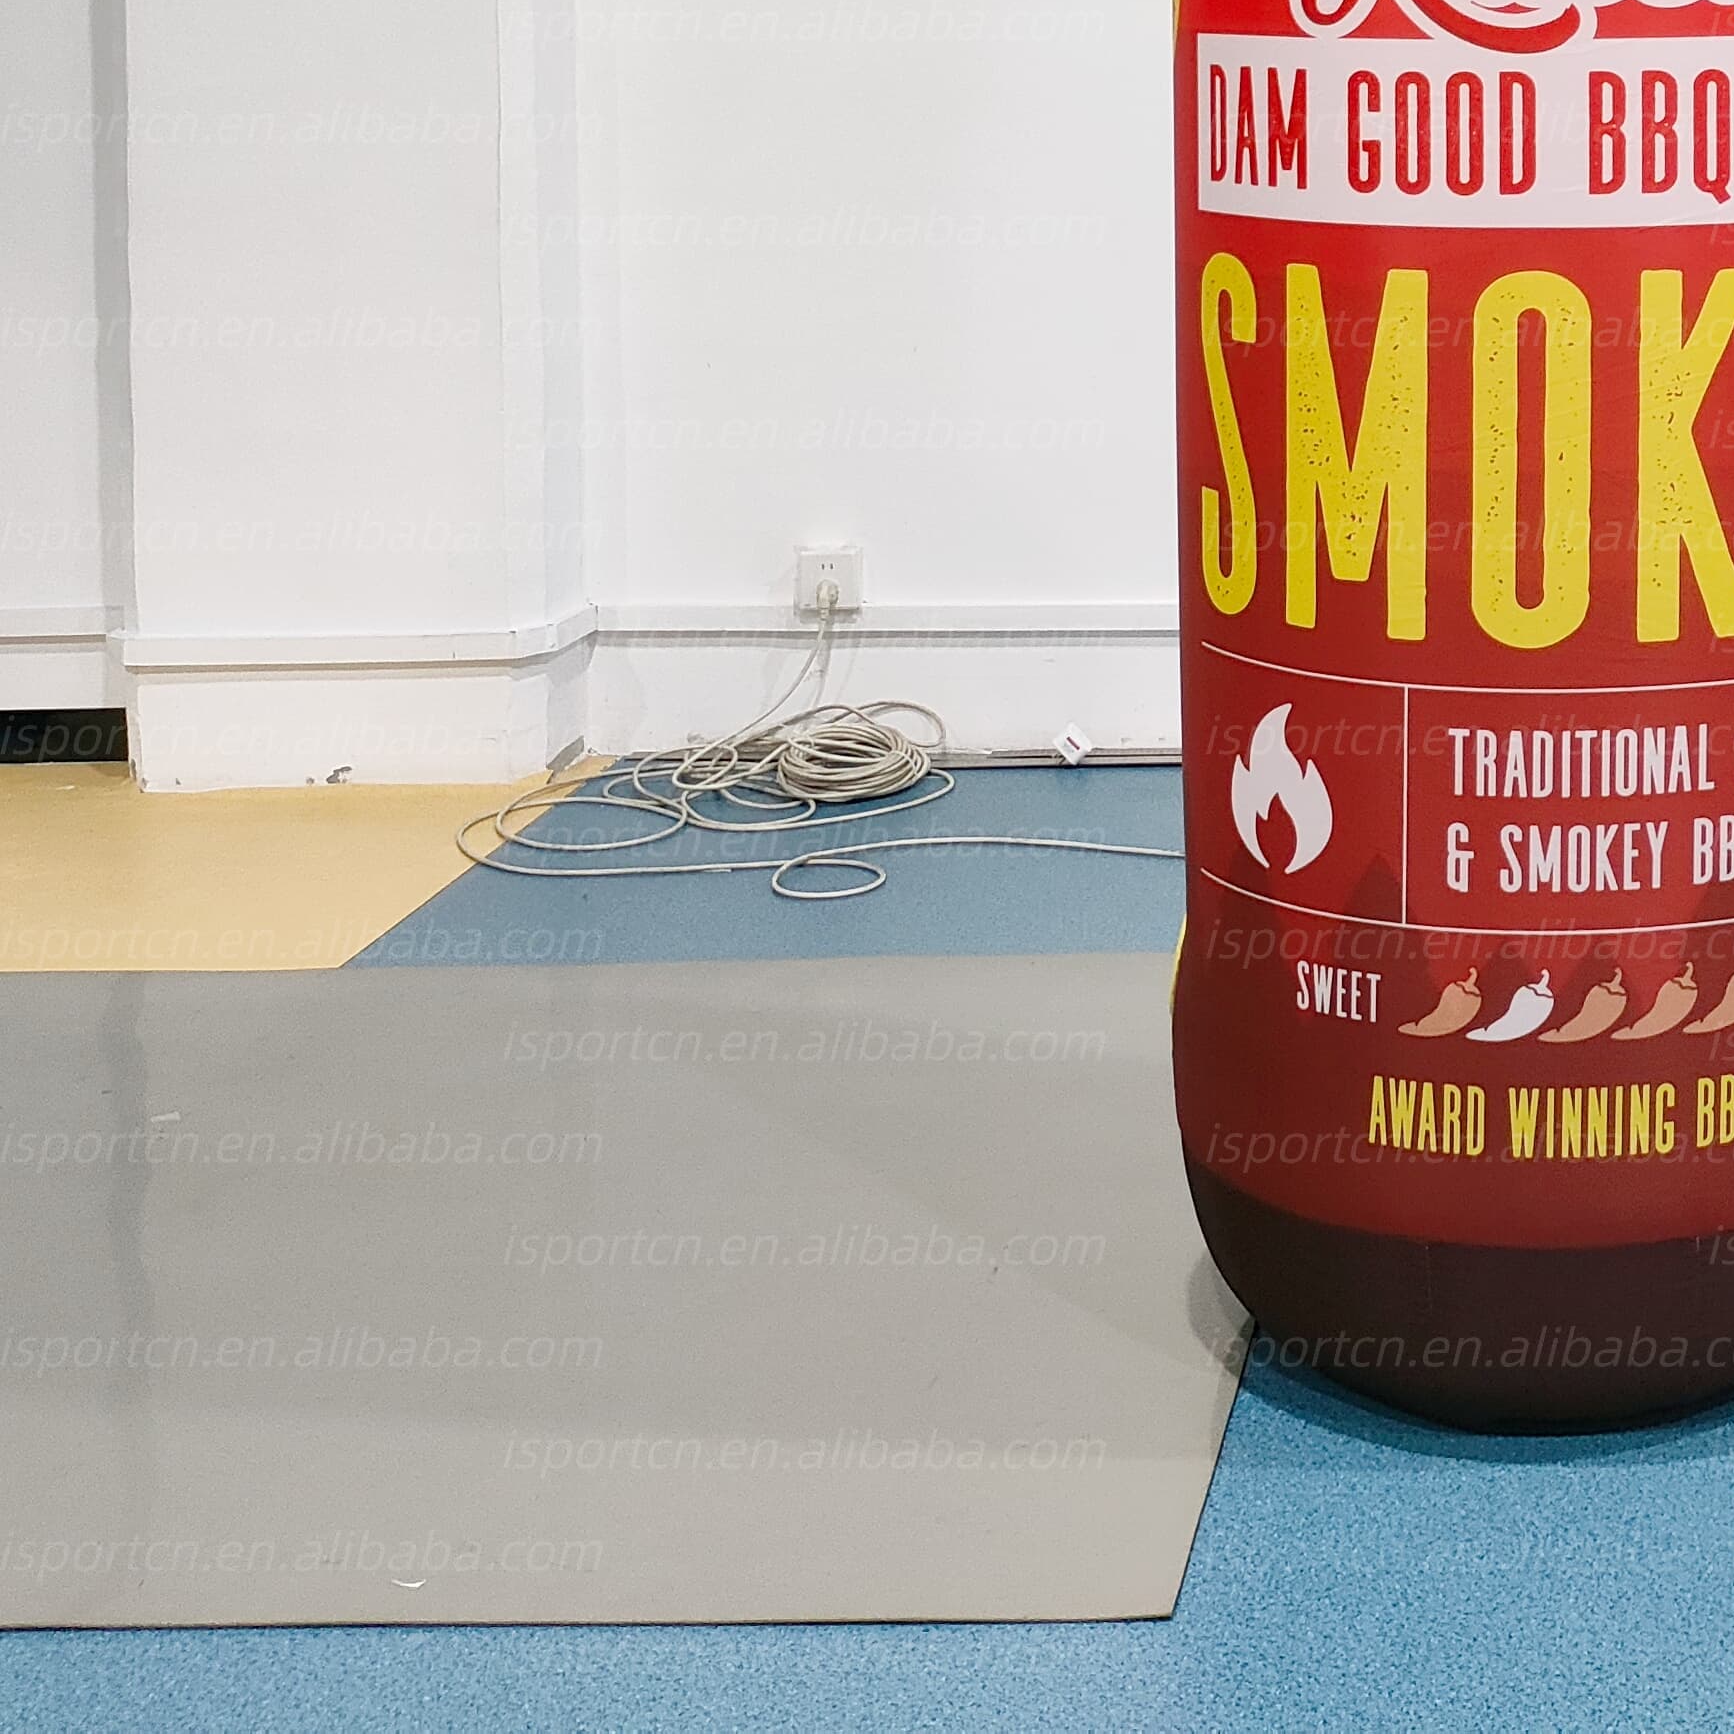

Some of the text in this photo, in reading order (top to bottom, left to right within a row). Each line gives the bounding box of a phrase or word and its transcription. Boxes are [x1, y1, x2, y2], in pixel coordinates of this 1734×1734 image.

[1209, 63, 1308, 190] DAM
[1347, 69, 1536, 197] GOOD
[1448, 725, 1716, 799] TRADITIONAL
[1447, 822, 1475, 893] &
[1500, 820, 1668, 894] SMOKEY
[1296, 959, 1382, 1023] SWEET
[1369, 1075, 1485, 1156] AWARD
[1509, 1081, 1676, 1159] WINNING
